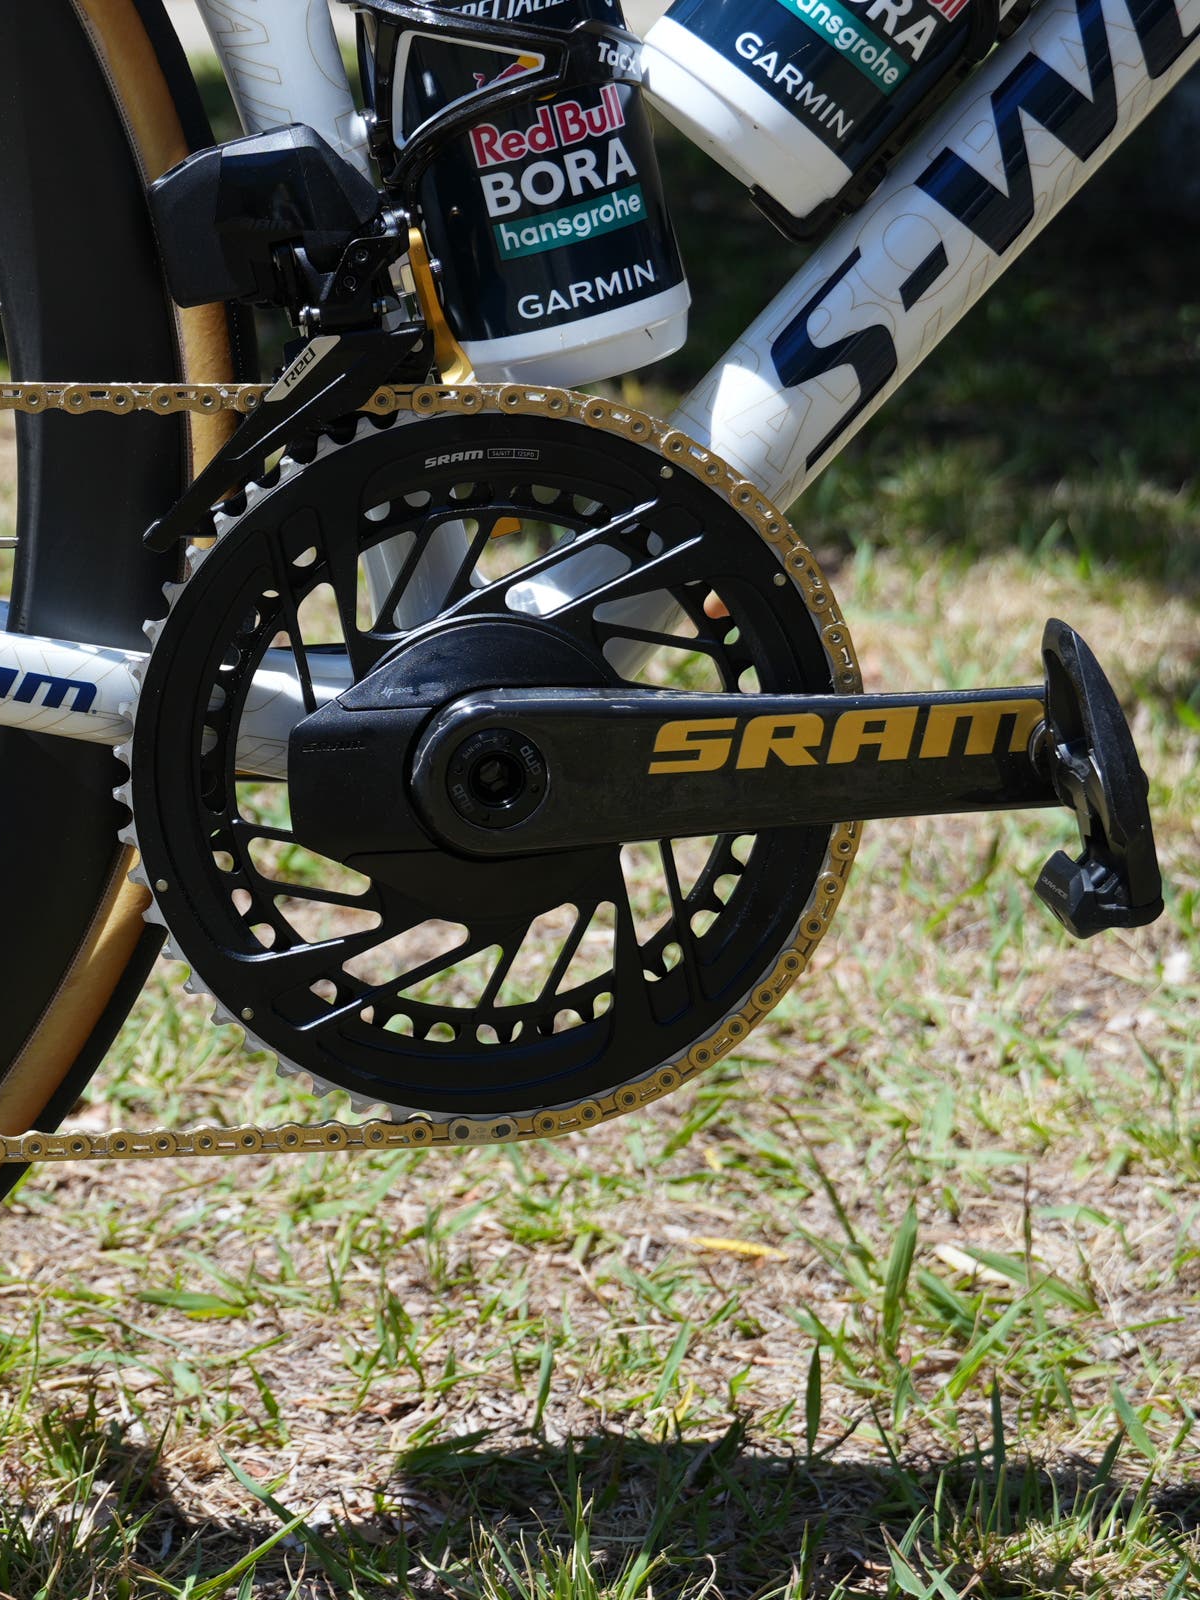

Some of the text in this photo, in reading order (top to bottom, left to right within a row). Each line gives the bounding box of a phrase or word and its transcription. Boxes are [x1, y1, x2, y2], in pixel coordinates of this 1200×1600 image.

[598, 42, 637, 74] Tacx
[790, 0, 899, 84] ansgrohe
[735, 32, 854, 139] GARMIN
[469, 83, 625, 168] Red Bull
[480, 137, 637, 217] BORA
[500, 190, 641, 251] hansgrohe
[518, 260, 656, 319] GARMIN
[424, 450, 484, 469] SRAM
[648, 699, 1044, 774] SRAM
